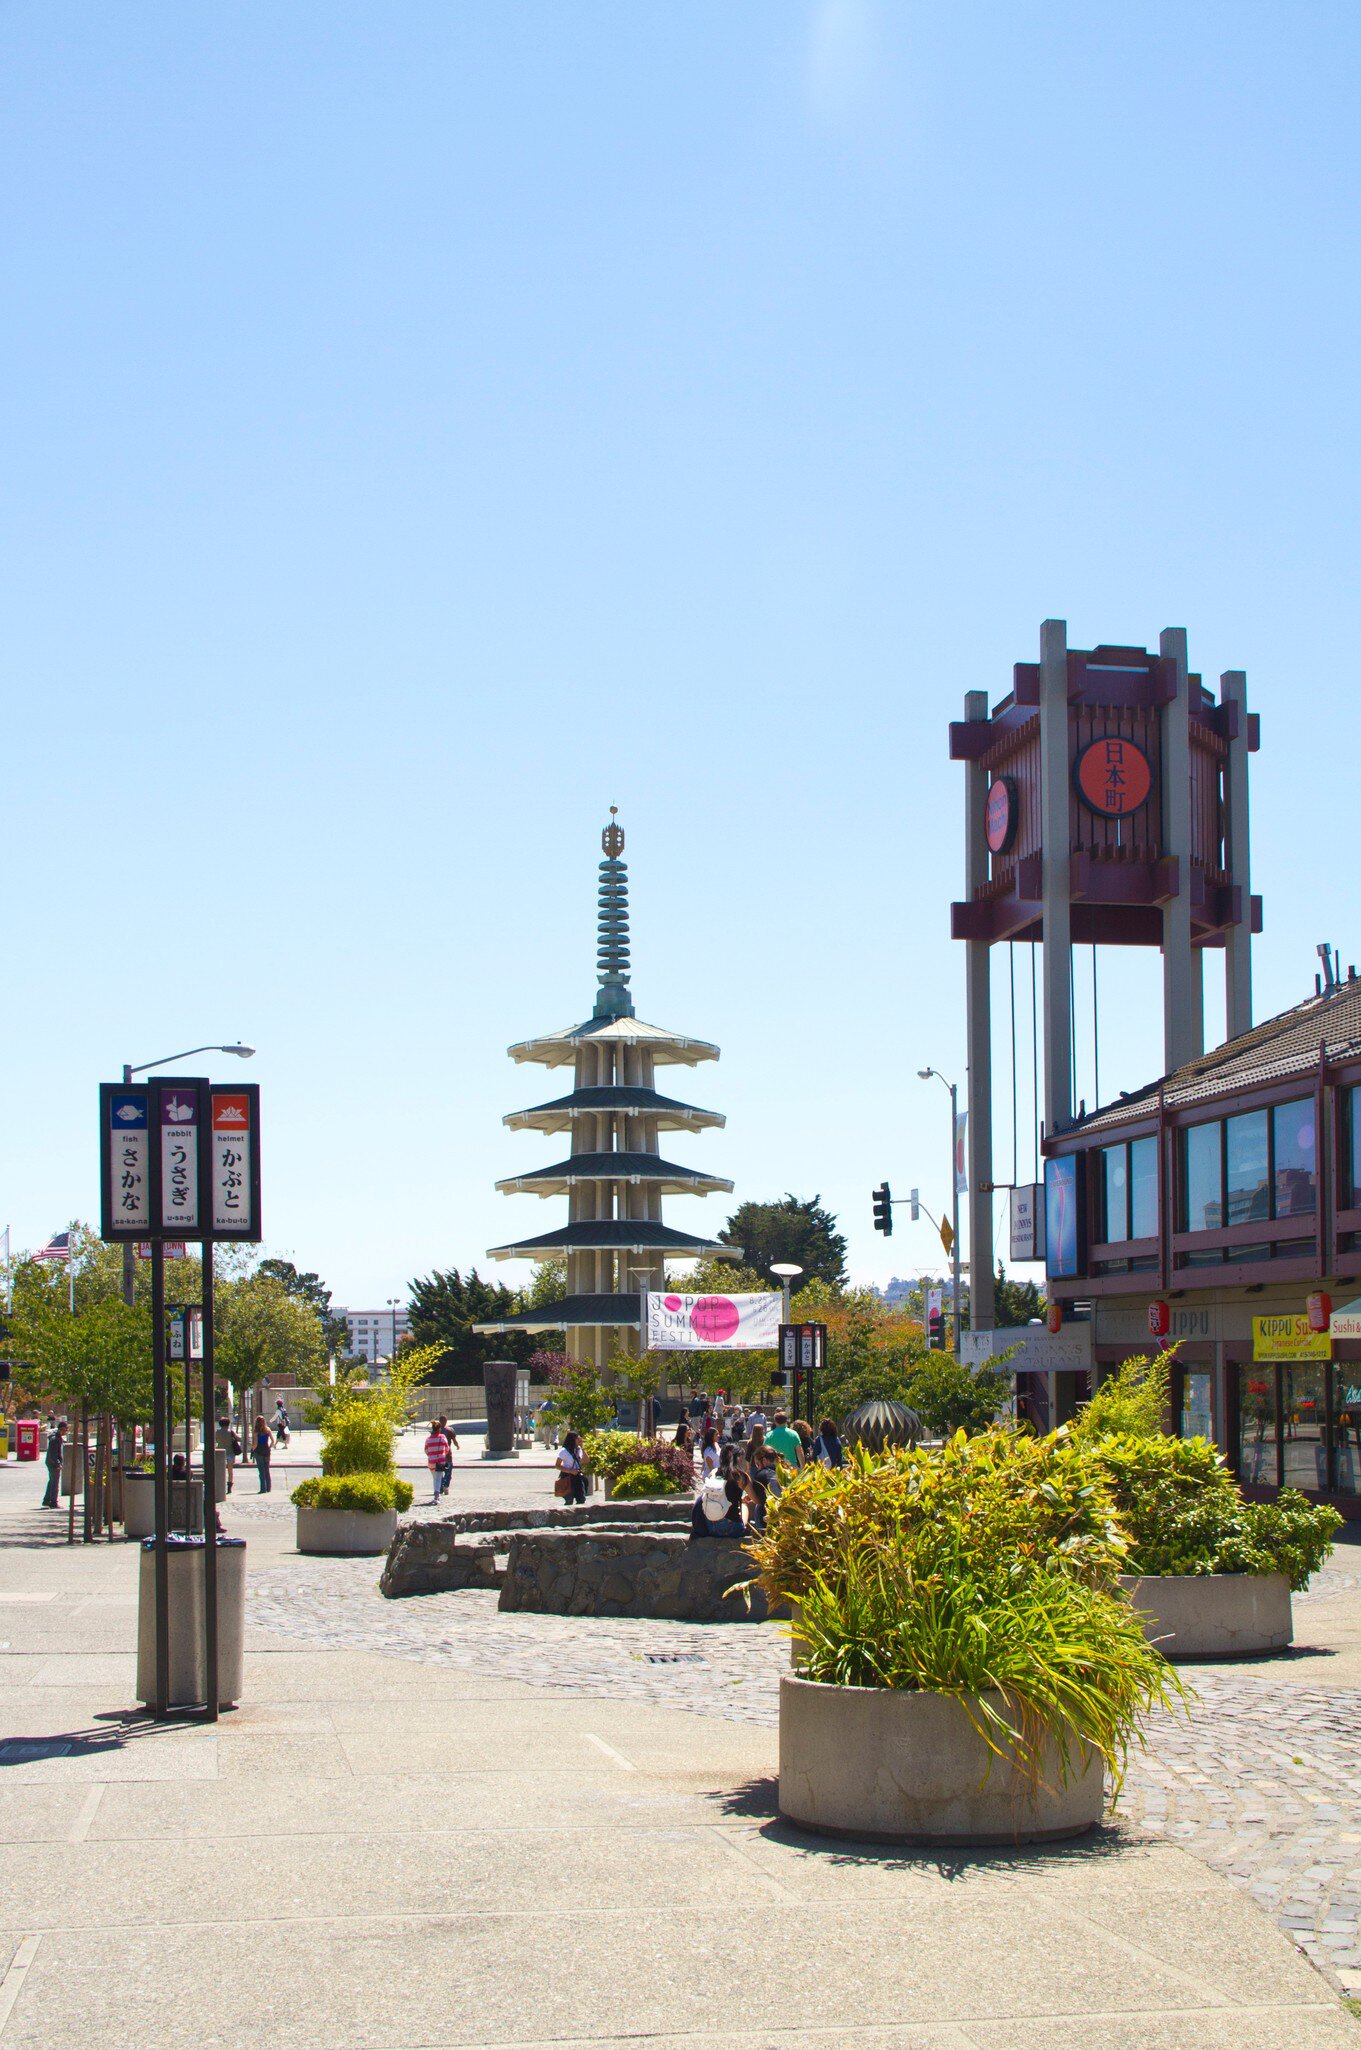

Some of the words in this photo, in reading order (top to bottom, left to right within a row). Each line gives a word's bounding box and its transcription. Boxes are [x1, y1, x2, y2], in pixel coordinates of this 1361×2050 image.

[1104, 741, 1127, 813] 日本町
[121, 1148, 142, 1211] さかな
[171, 1145, 190, 1206] うさぎ
[221, 1149, 243, 1209] かぶと
[652, 1295, 661, 1311] J
[685, 1295, 719, 1312] POP
[652, 1314, 719, 1329] SUMMIT
[1167, 1310, 1209, 1335] IPPU
[1259, 1318, 1292, 1337] KIPPU
[1333, 1319, 1355, 1333] Sushi
[652, 1330, 719, 1342] FESTIVAL
